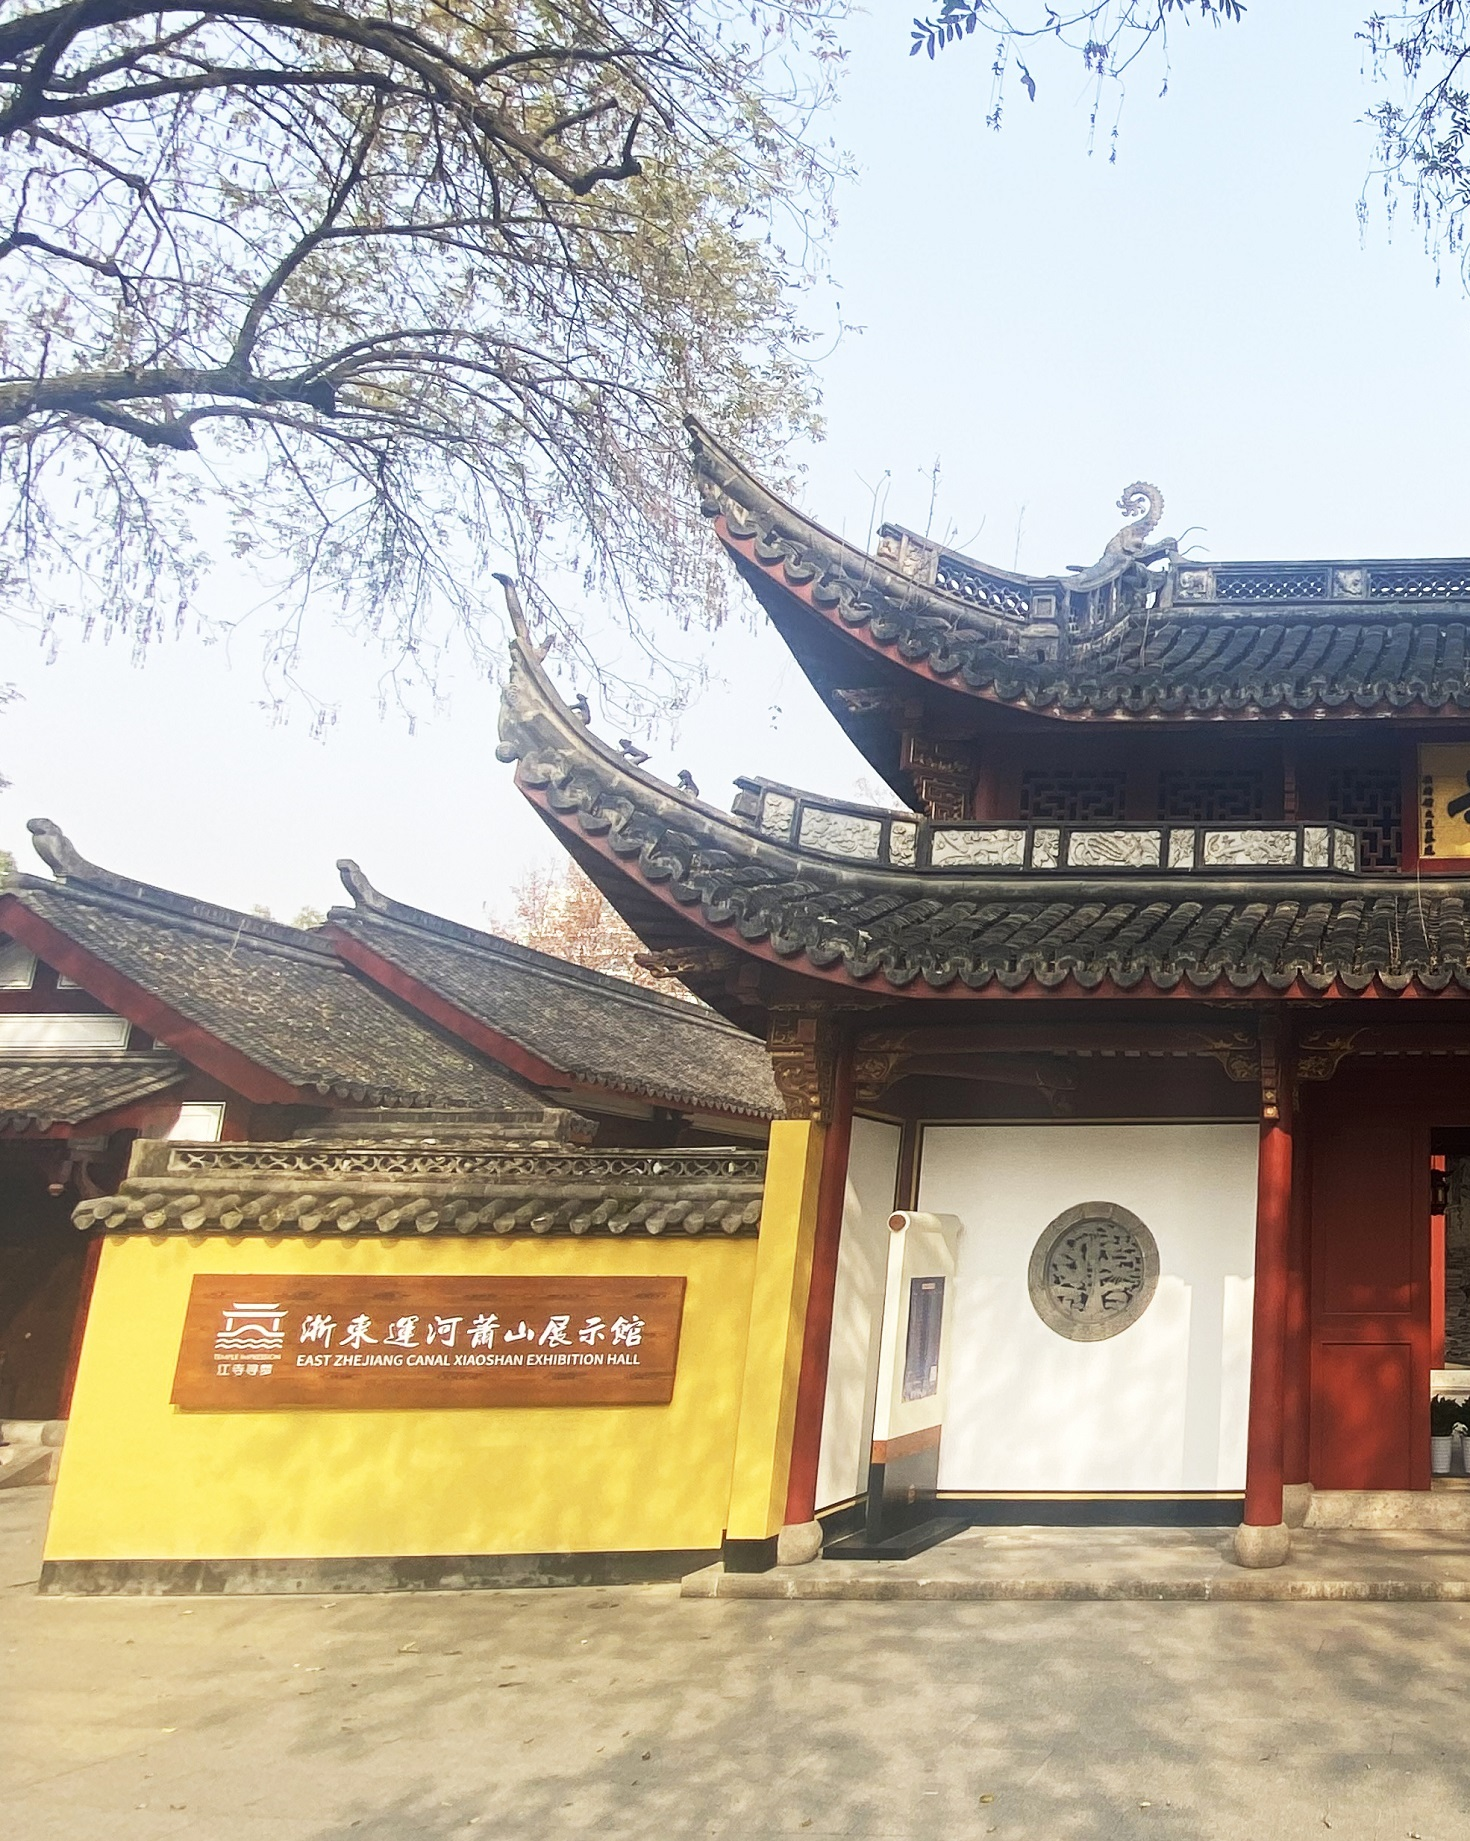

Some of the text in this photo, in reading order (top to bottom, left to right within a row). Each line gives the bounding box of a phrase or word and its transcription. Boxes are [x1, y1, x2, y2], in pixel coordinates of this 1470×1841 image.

[296, 1353, 641, 1367] EAST ZHEJIANG CANAL XIAOSHAN EXHIBITION HALL
